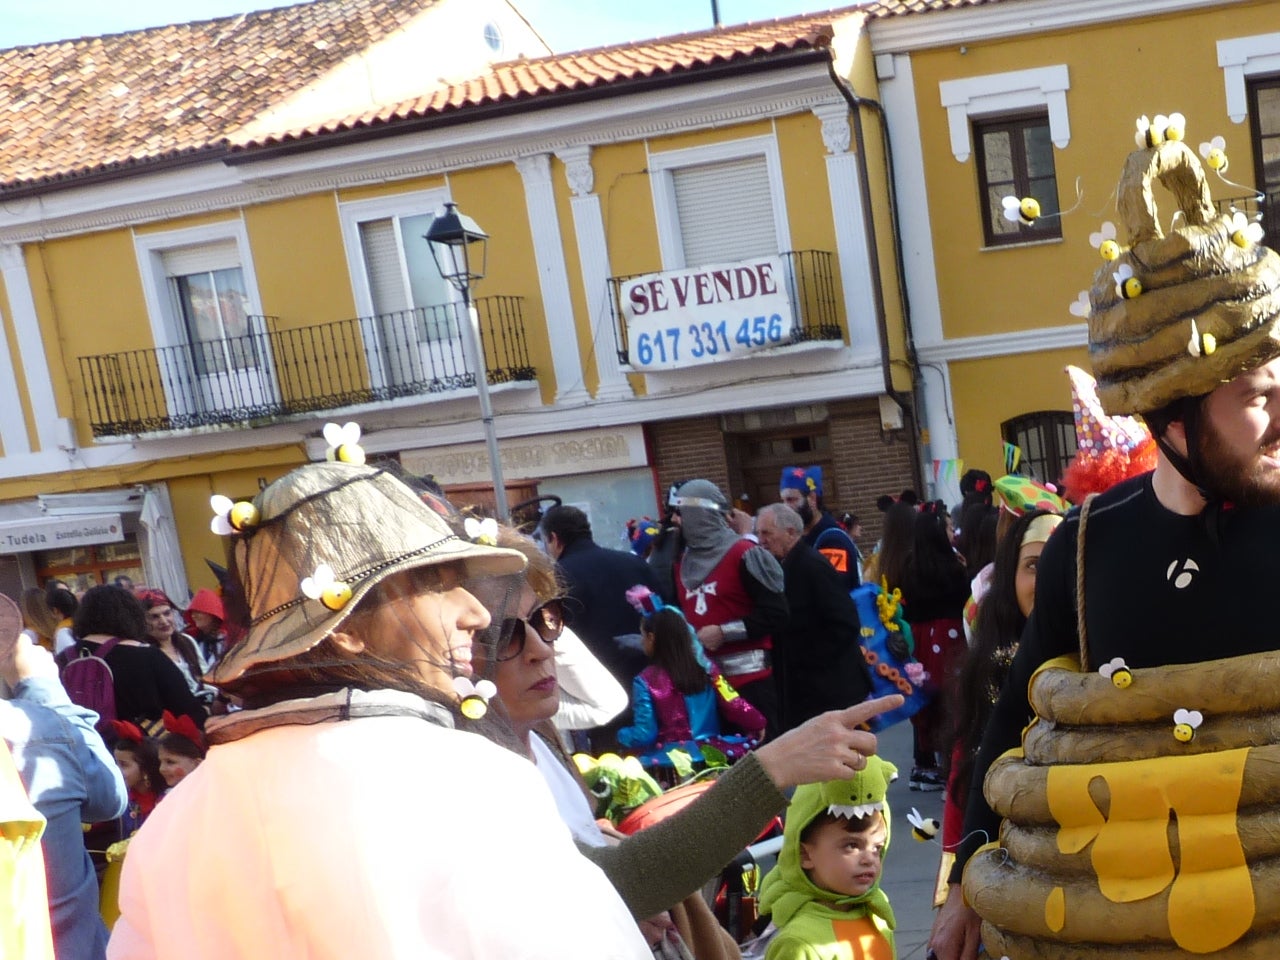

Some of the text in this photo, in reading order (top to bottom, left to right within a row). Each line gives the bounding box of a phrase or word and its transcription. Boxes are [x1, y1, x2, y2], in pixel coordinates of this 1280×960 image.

[629, 262, 778, 316] SE VENDE
[637, 313, 782, 366] 617 331 456
[6, 533, 47, 546] Tudela
